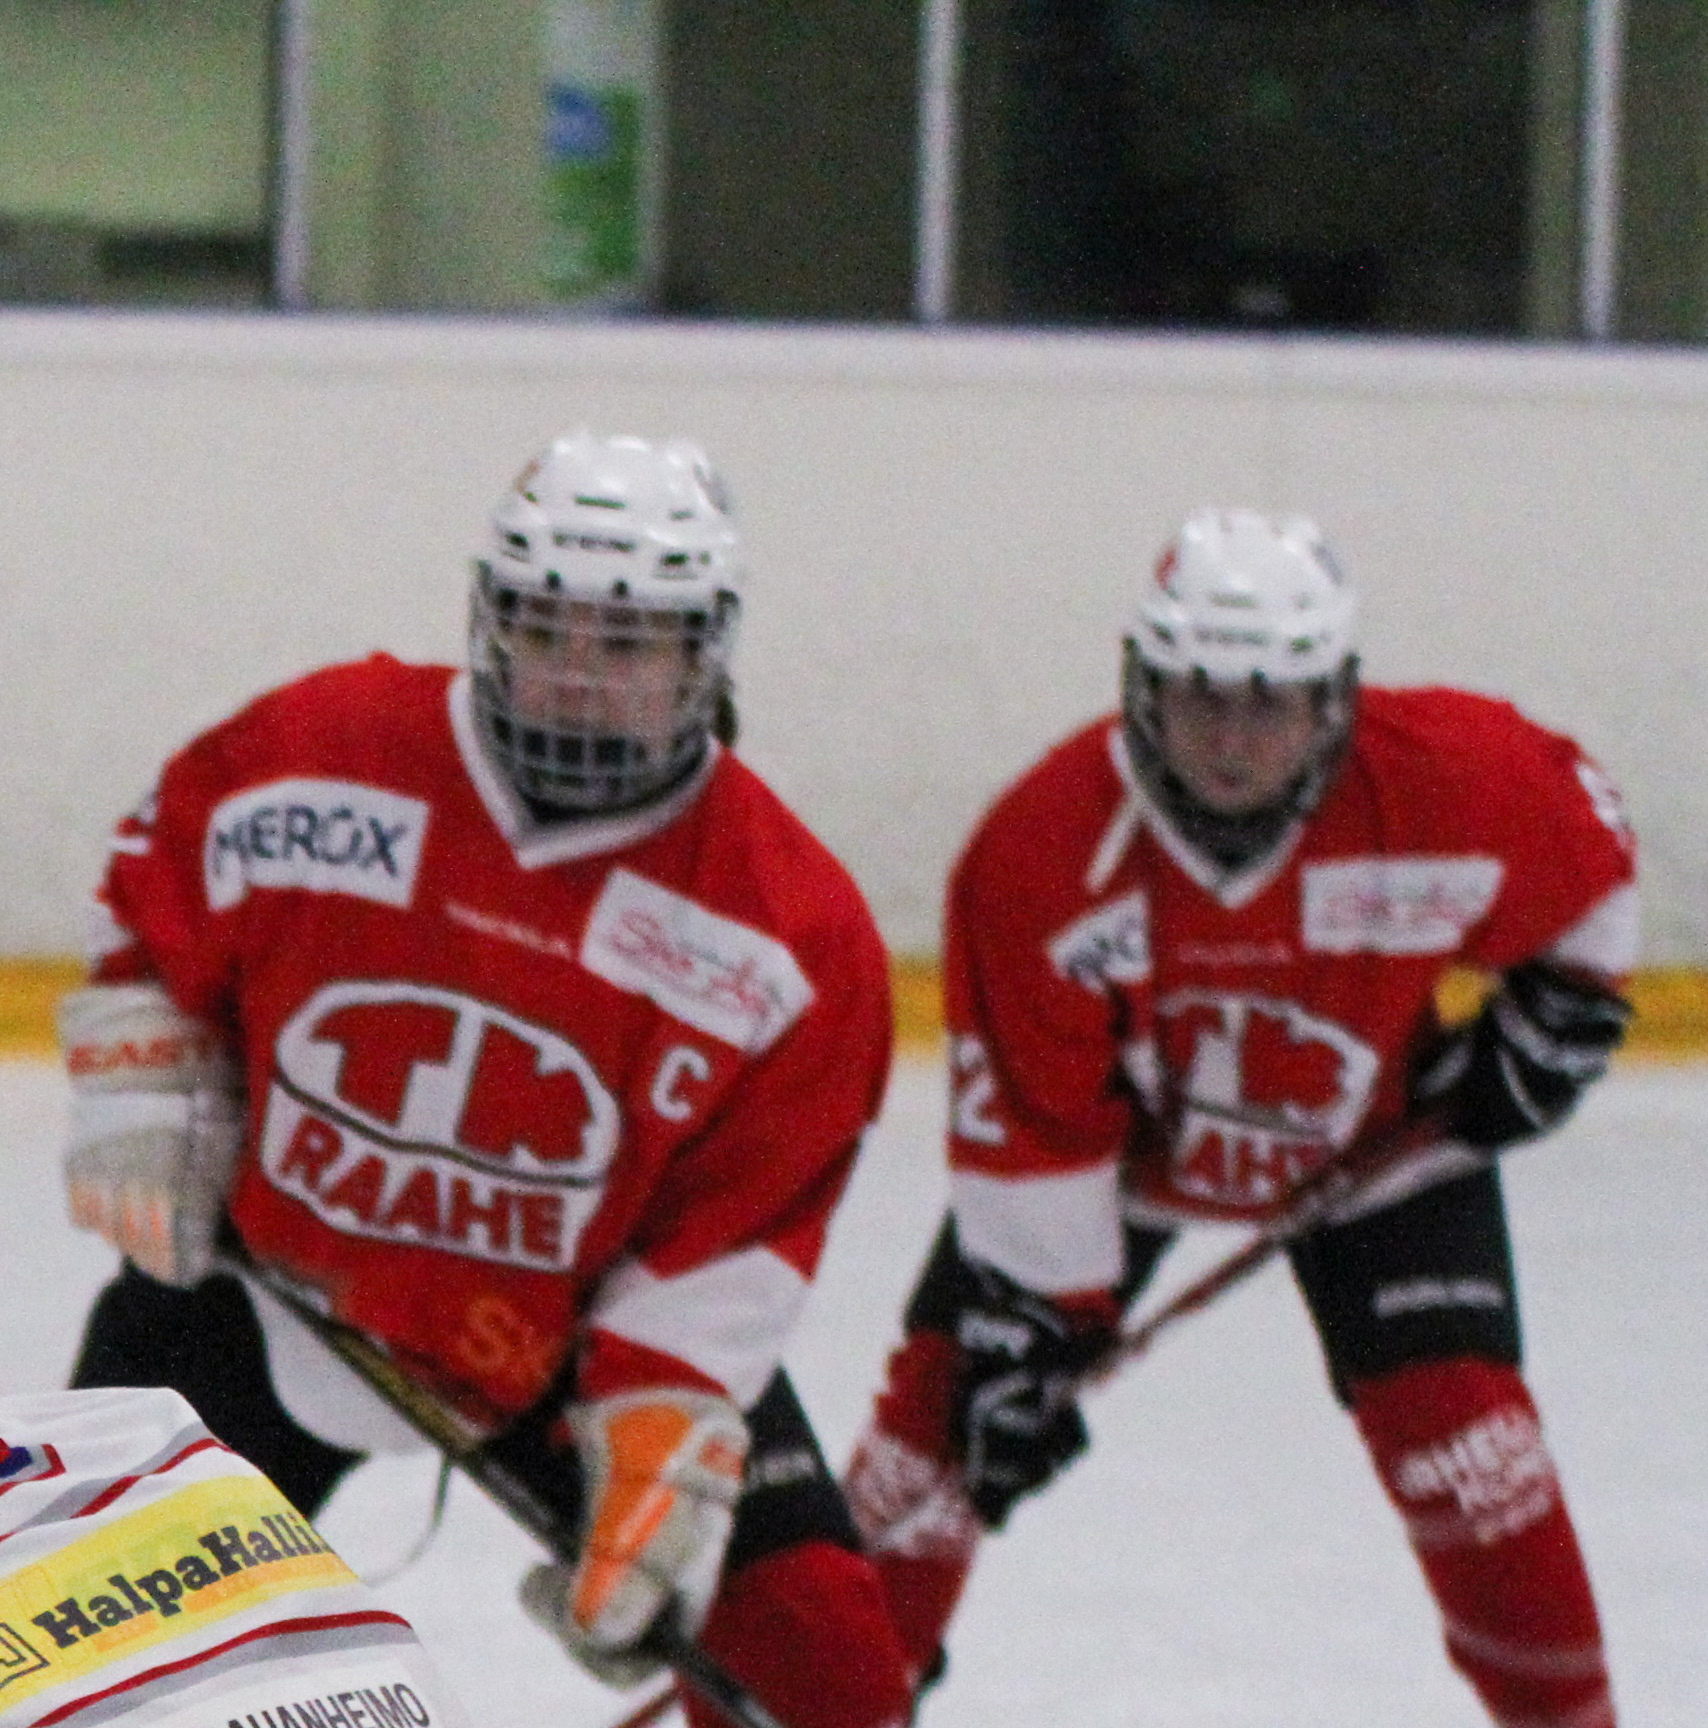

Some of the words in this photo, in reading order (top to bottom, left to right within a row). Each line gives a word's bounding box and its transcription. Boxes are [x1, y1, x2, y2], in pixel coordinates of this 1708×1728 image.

[214, 801, 405, 878] MEROX
[649, 1045, 710, 1122] C
[279, 1112, 565, 1260] RAAHE
